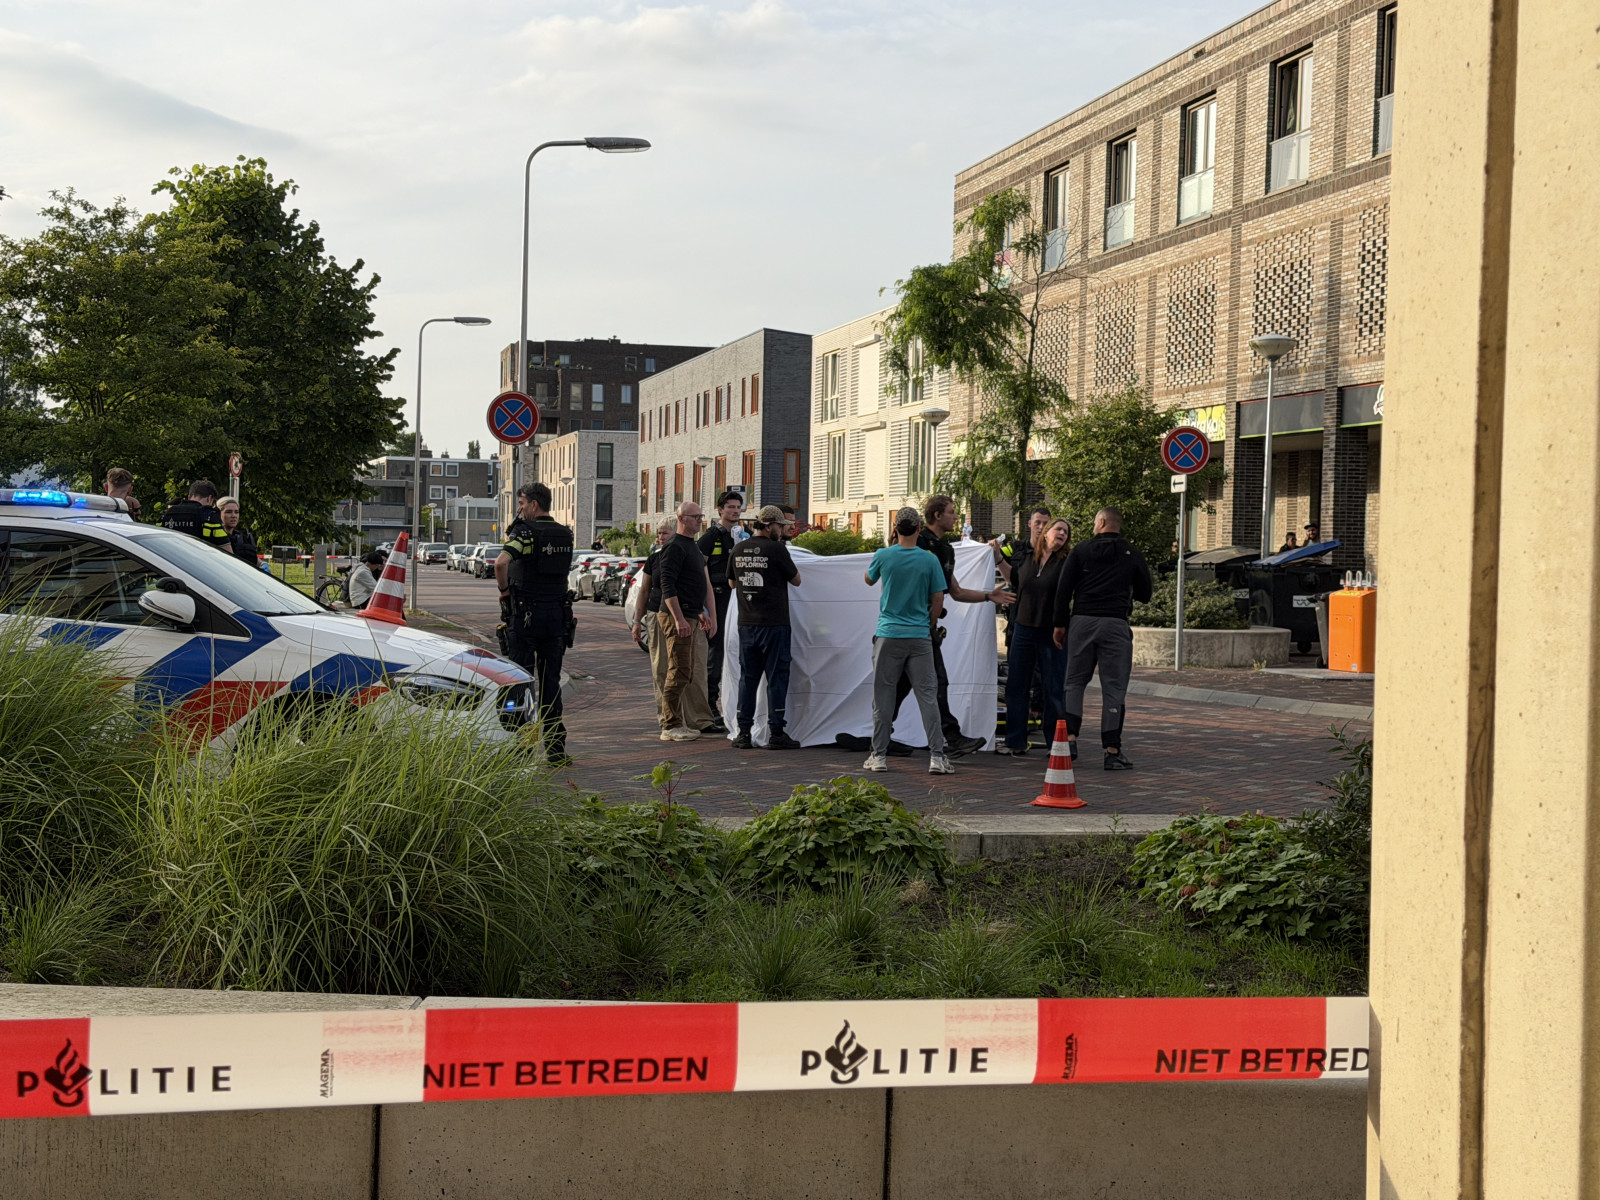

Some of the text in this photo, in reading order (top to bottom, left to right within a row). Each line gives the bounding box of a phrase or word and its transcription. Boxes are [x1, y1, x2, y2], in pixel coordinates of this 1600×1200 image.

[542, 542, 571, 555] POLITIE
[800, 1019, 989, 1085] POLITIE
[1155, 1048, 1369, 1073] NIET BETRED
[17, 1038, 231, 1108] POLITIE
[320, 1048, 330, 1098] MAGEMA
[423, 1057, 708, 1088] NIET BETREDEN
